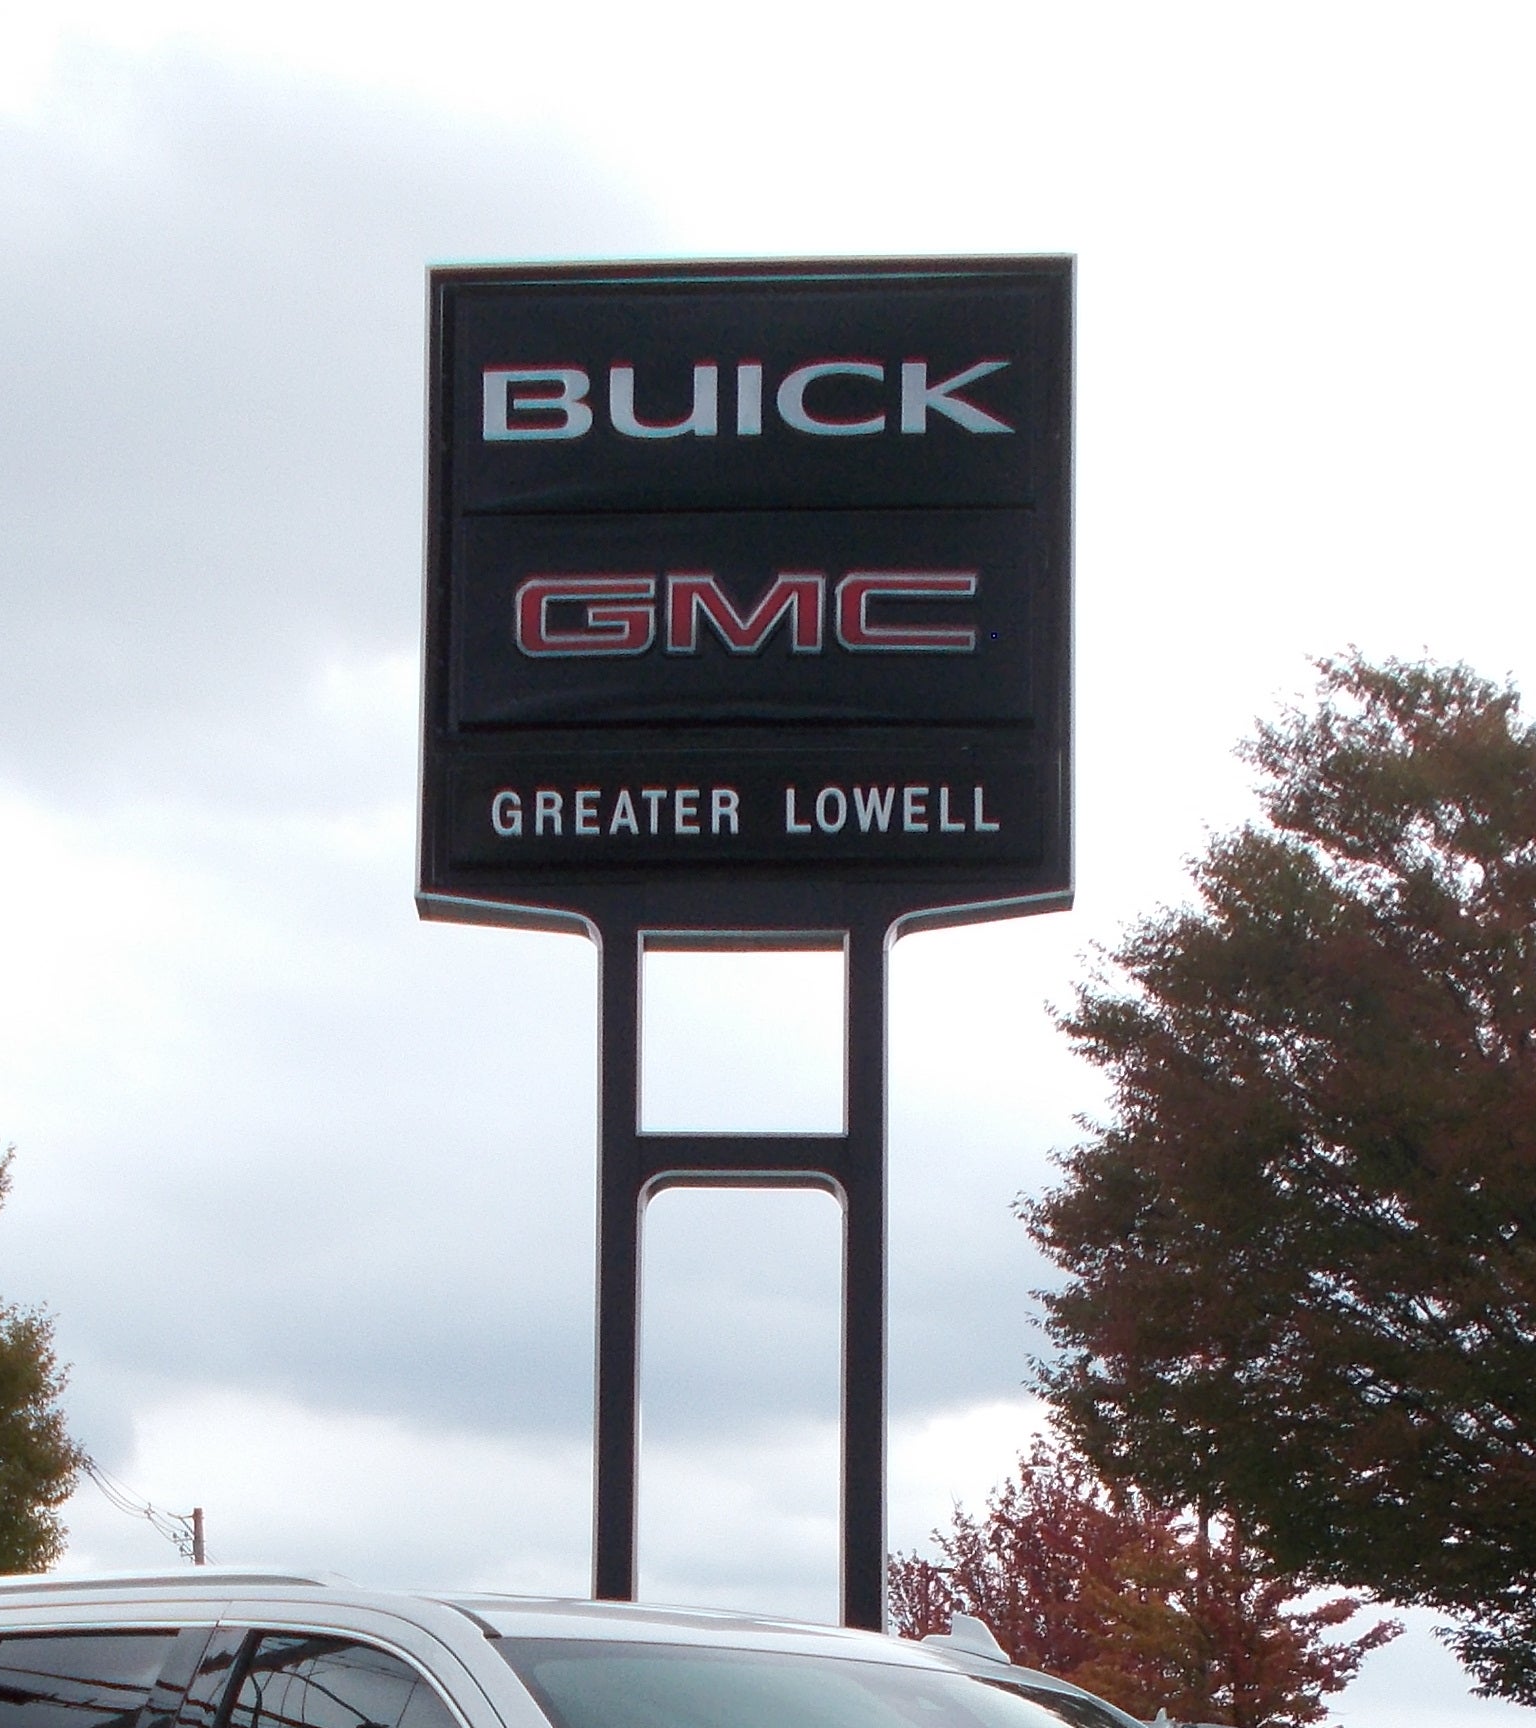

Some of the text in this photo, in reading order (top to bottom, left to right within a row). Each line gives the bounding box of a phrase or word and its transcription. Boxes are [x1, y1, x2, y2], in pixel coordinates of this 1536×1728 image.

[483, 361, 1015, 441] BUICK
[515, 570, 978, 657] GMC
[491, 786, 1000, 836] GREATER LOWELL
